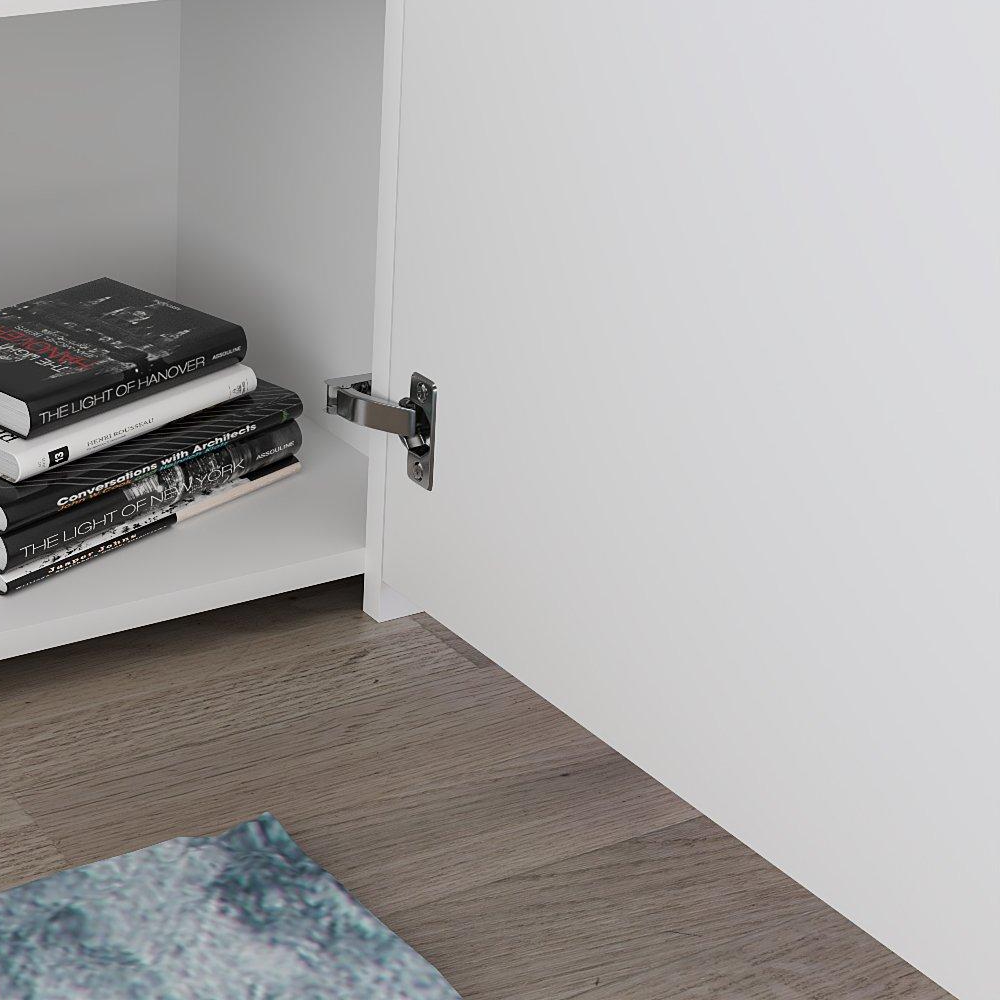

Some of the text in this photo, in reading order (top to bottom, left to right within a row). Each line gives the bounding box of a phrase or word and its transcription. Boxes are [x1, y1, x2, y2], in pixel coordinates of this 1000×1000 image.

[212, 345, 242, 361] ASSOULINE
[39, 404, 69, 425] THE
[71, 388, 114, 415] LIGHT
[115, 380, 138, 398] OF
[138, 356, 206, 390] HANOVER
[86, 431, 109, 447] HENRI
[108, 417, 155, 440] ROUSSEAU
[54, 450, 65, 463] 13
[255, 439, 295, 460] ASSOULINE
[56, 461, 158, 506] Conversations
[160, 449, 189, 465] with
[192, 423, 257, 453] Architects
[19, 533, 60, 558] THE
[62, 508, 119, 543] LIGHT
[121, 498, 148, 518] OF
[150, 478, 194, 507] NEW
[195, 458, 245, 486] YORK
[98, 533, 138, 553] Johns
